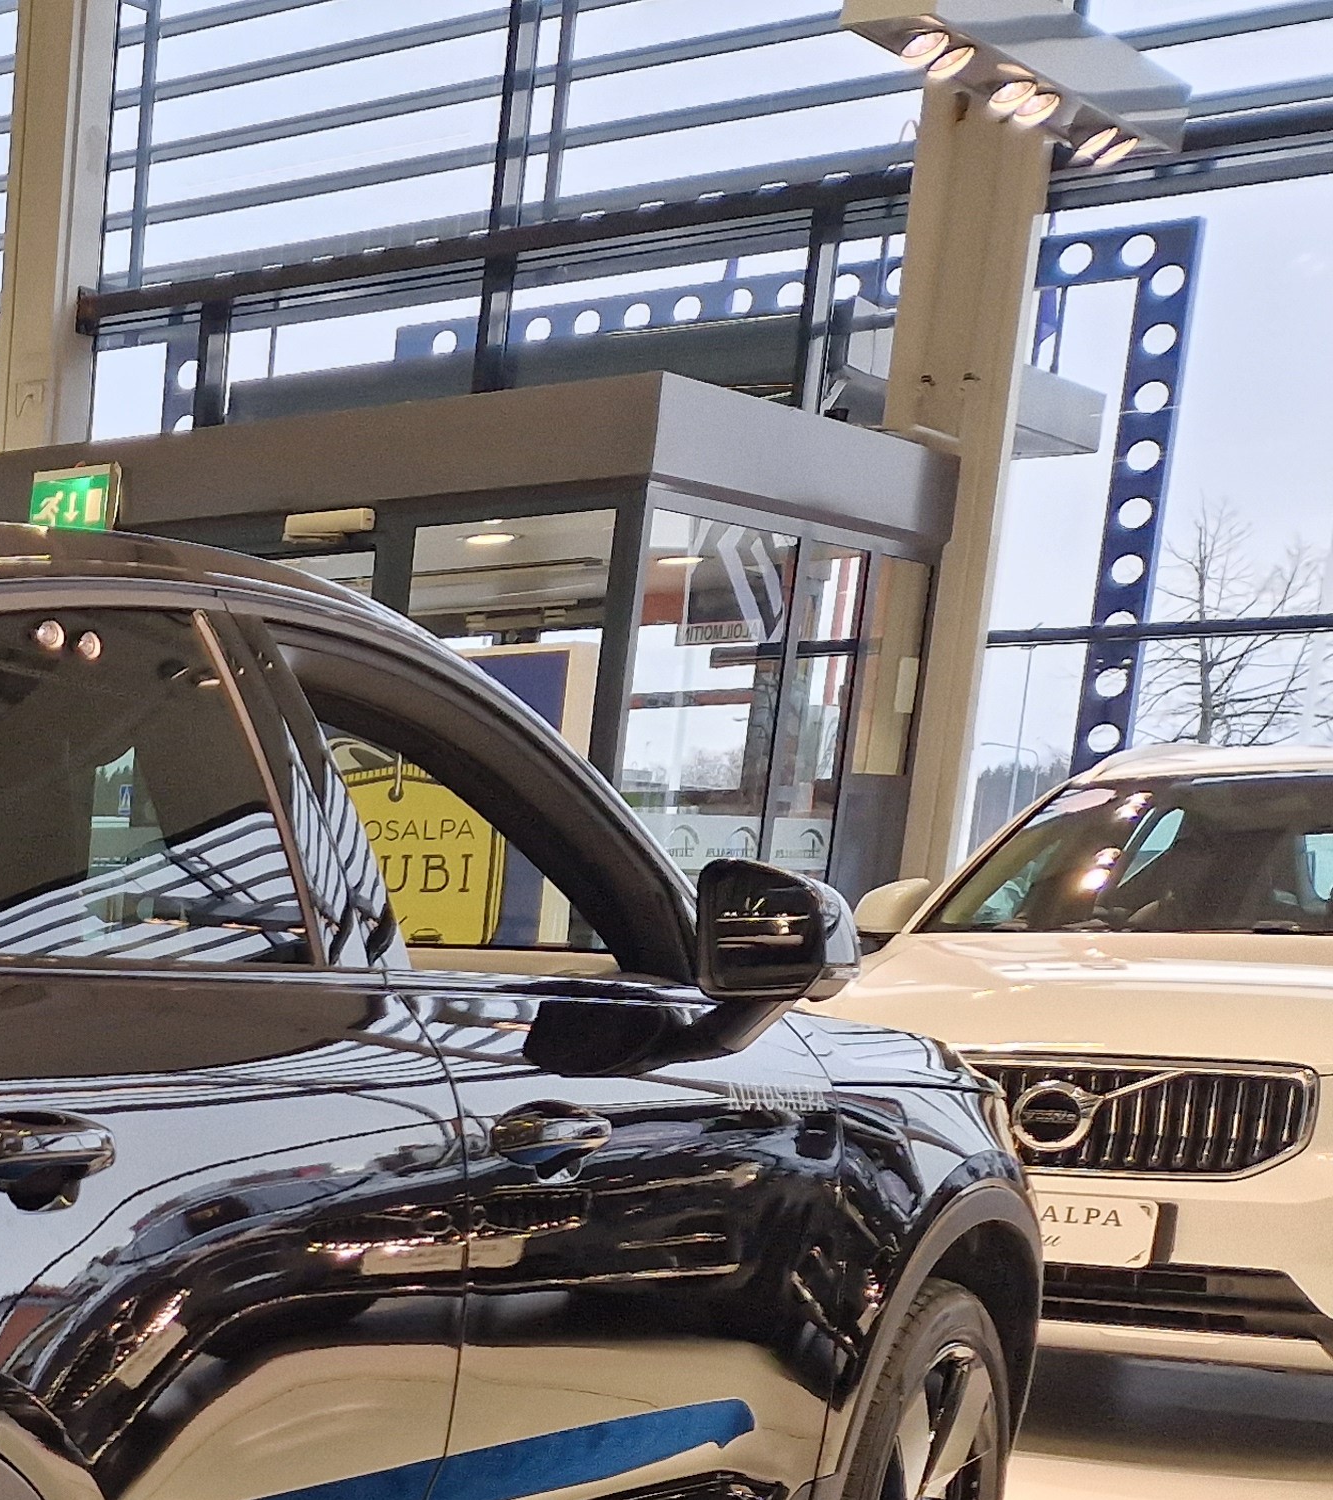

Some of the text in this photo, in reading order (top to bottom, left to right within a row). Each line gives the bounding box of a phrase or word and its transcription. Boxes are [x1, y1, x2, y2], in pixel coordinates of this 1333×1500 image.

[364, 818, 475, 841] OSALPA
[380, 853, 473, 893] UBI
[1040, 1204, 1123, 1228] ALPA
